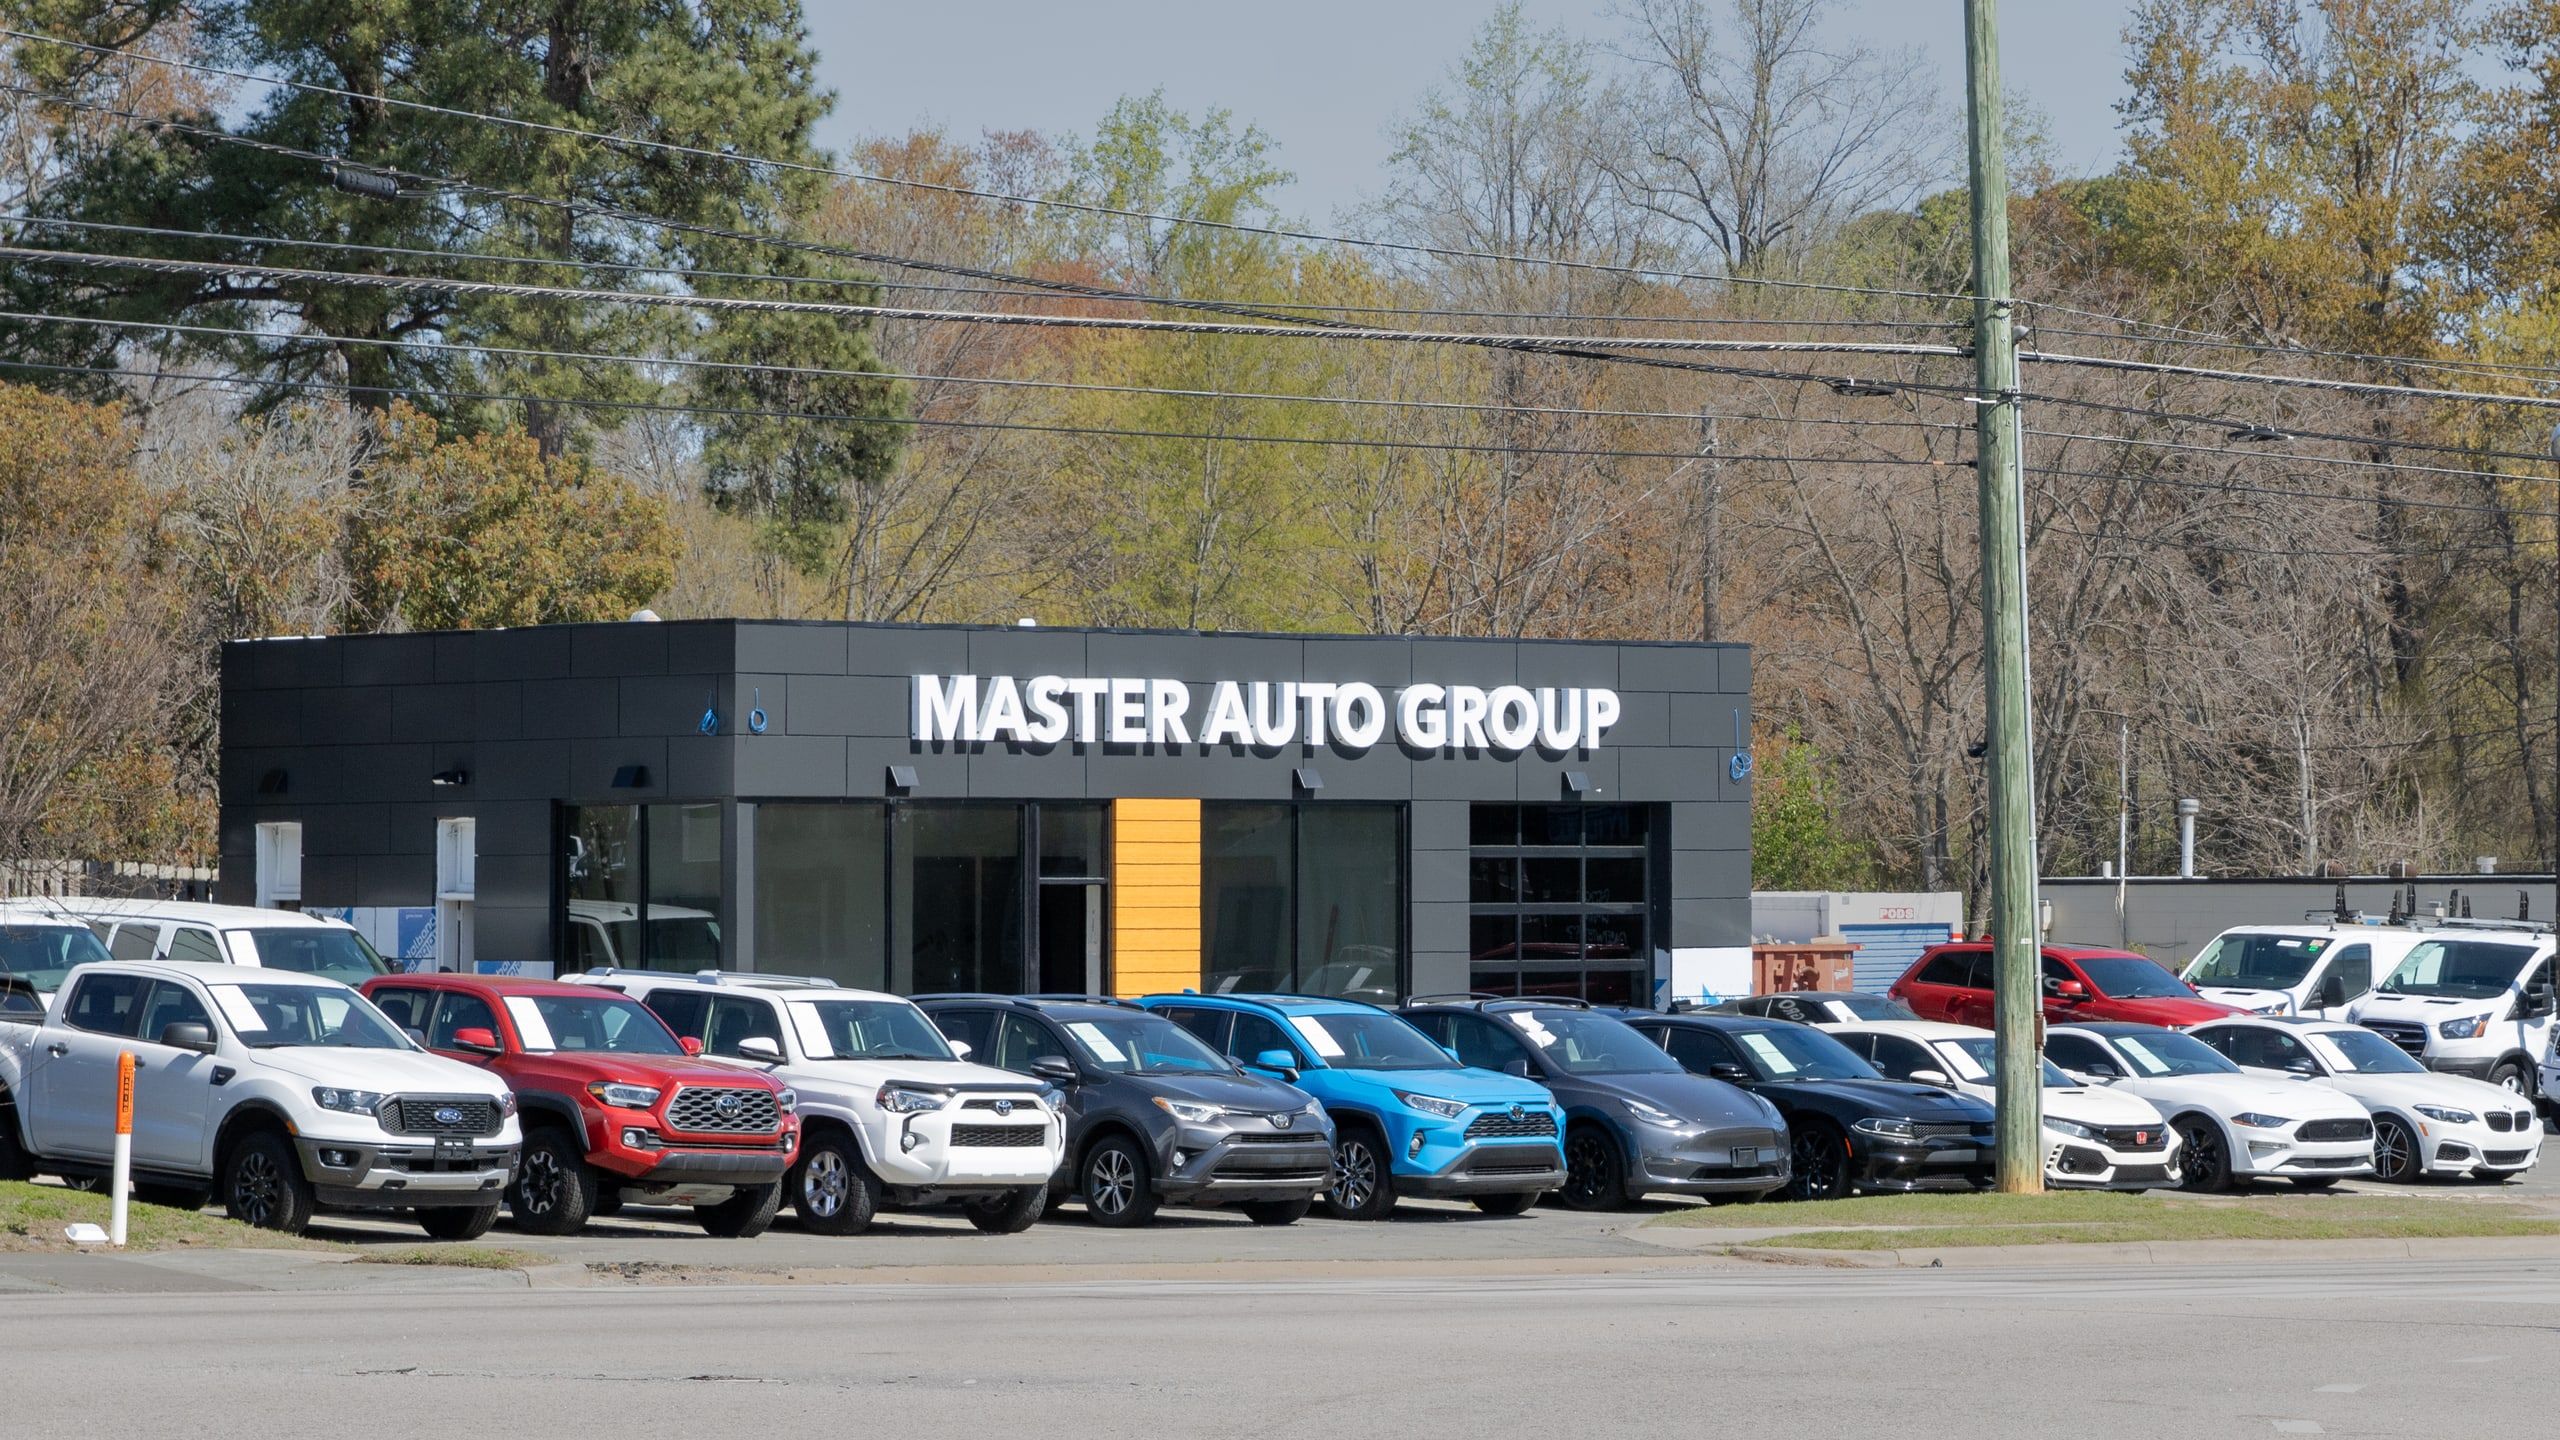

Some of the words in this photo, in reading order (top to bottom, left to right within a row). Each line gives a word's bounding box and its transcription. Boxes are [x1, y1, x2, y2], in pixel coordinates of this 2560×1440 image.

[912, 674, 1192, 743] MASTER
[1200, 681, 1386, 748] AUTO
[1397, 683, 1621, 750] GROUP
[1880, 908, 1914, 919] PODS
